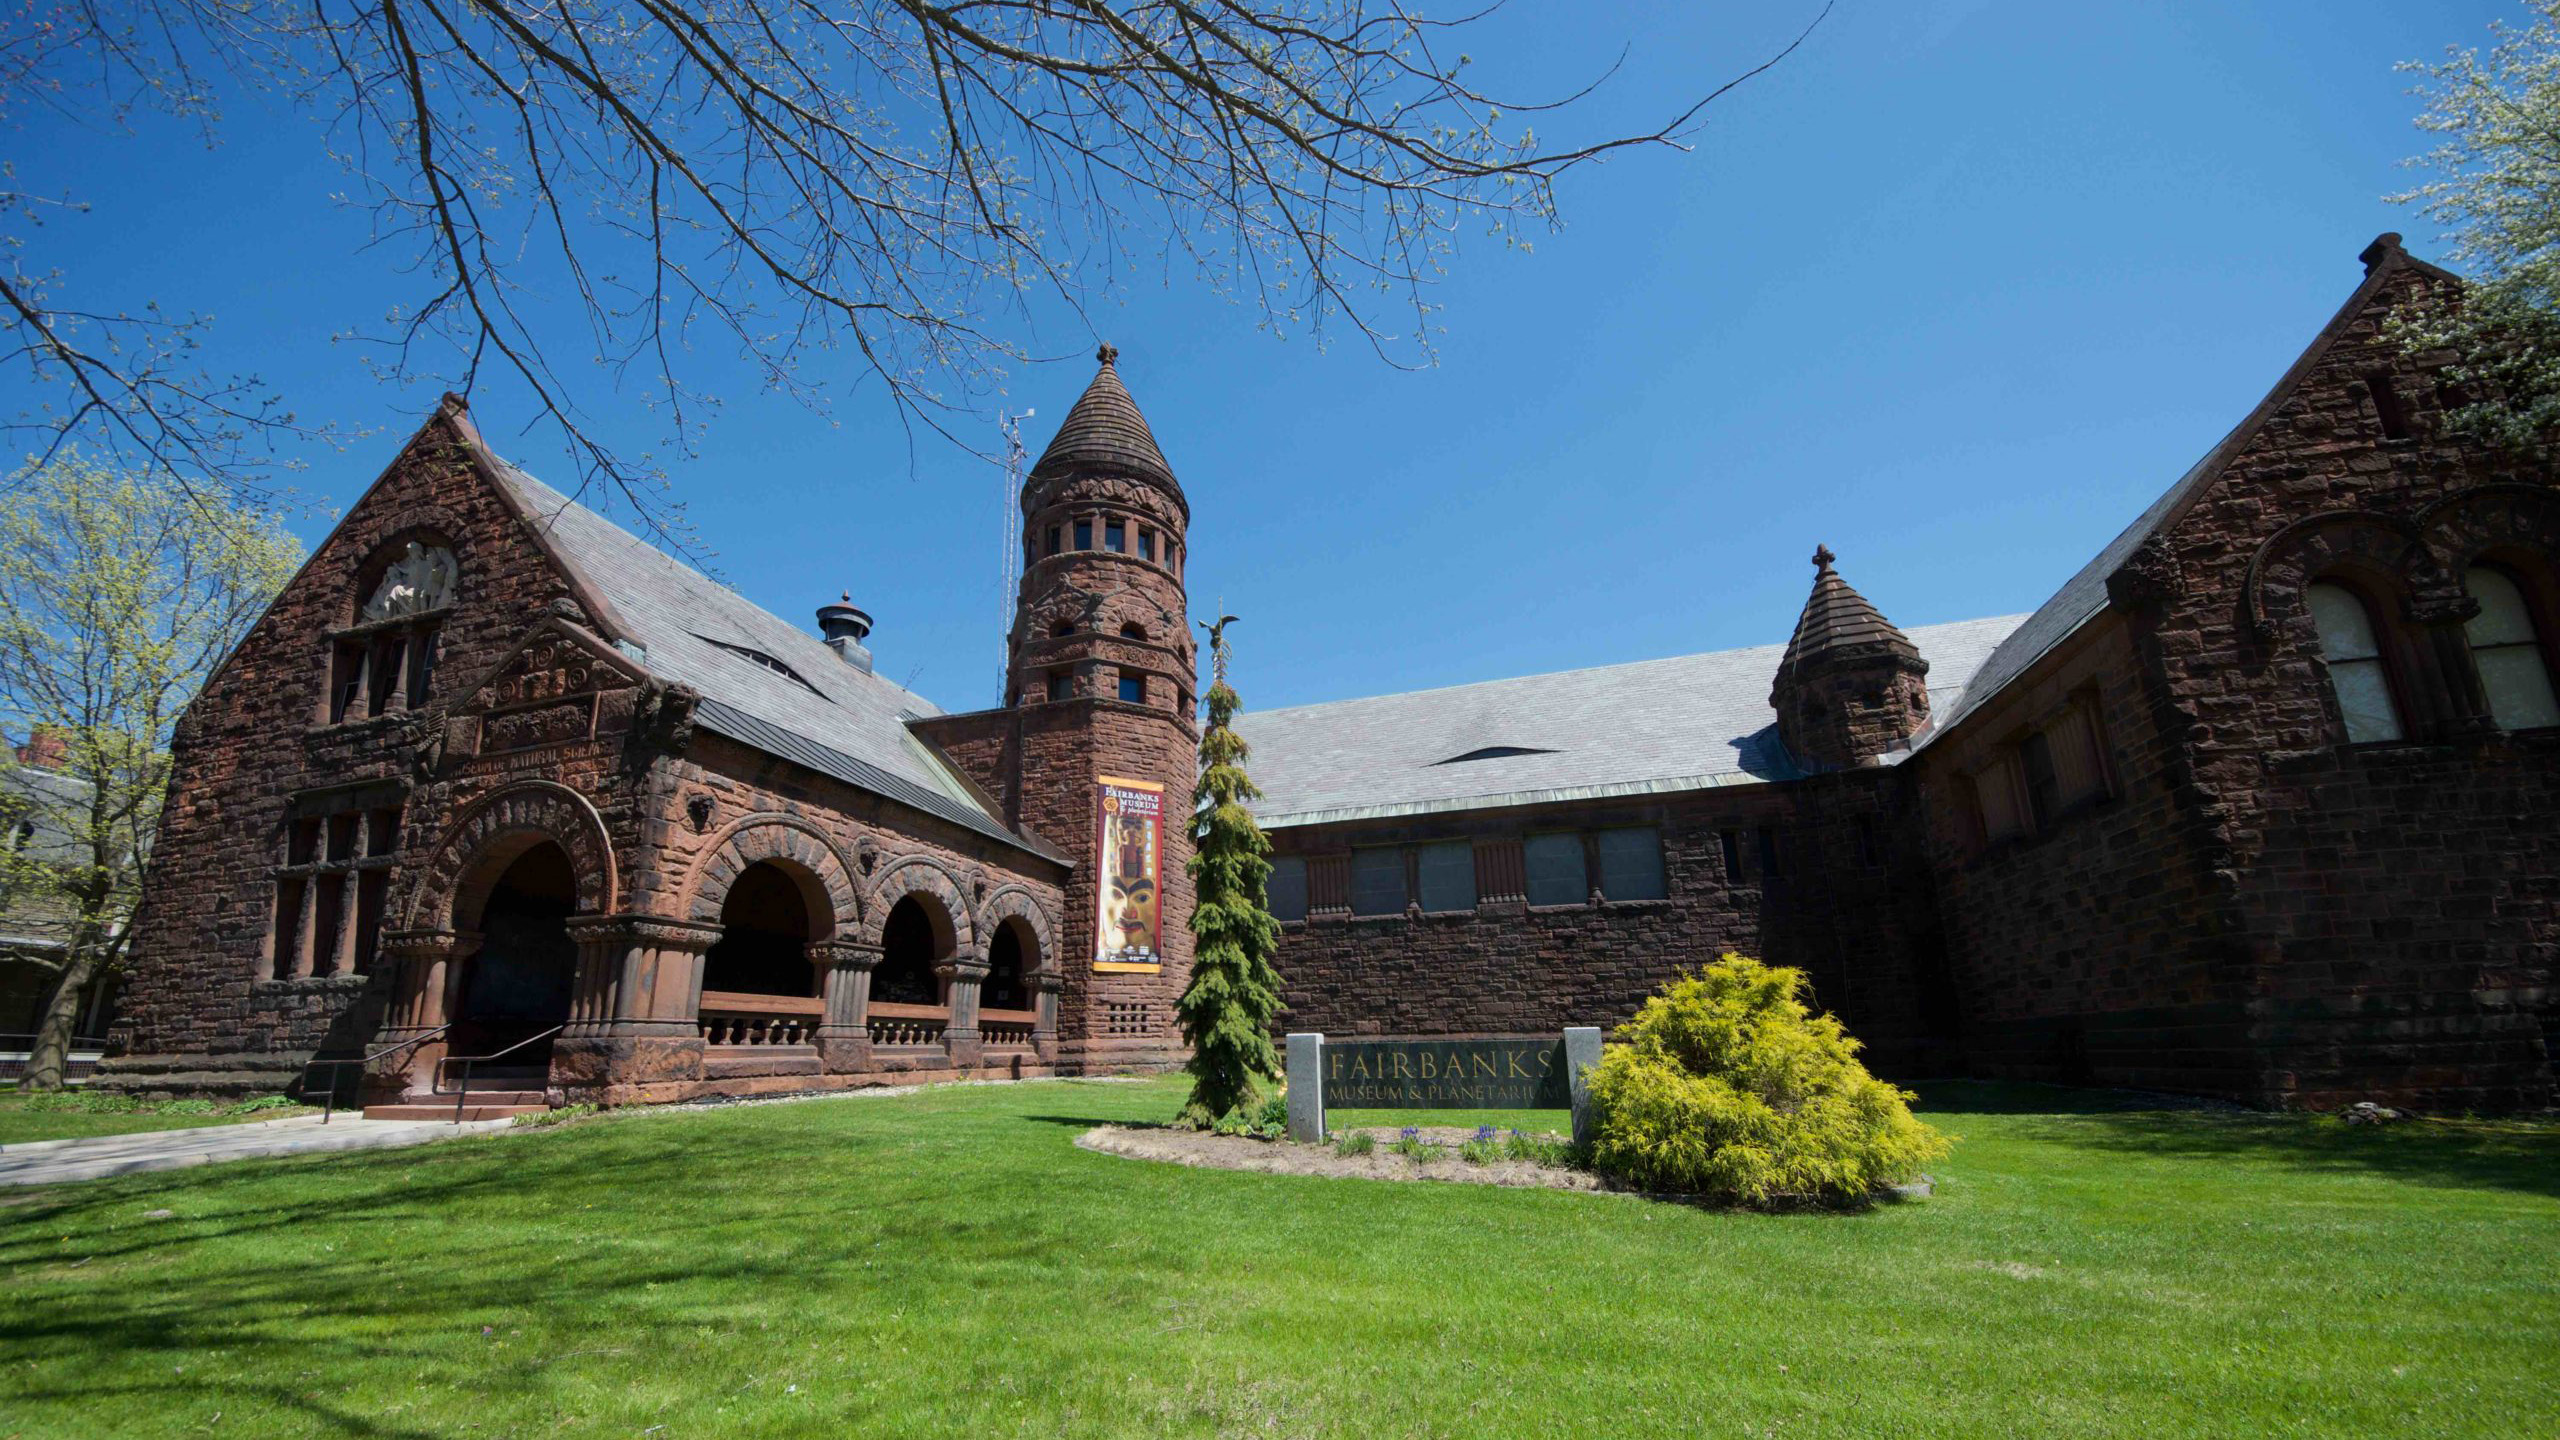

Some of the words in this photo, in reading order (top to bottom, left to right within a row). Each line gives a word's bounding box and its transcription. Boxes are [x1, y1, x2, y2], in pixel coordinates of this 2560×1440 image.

[510, 749, 557, 769] NATURAL
[563, 742, 606, 758] SCIEN
[1105, 787, 1159, 802] FAIRBANKS
[1120, 799, 1159, 809] MUSEUM
[1330, 1050, 1553, 1079] FAIRBANKS
[1329, 1085, 1403, 1100] MUSEUM
[1408, 1085, 1425, 1100] &
[1428, 1083, 1560, 1101] PLANETARIUM
